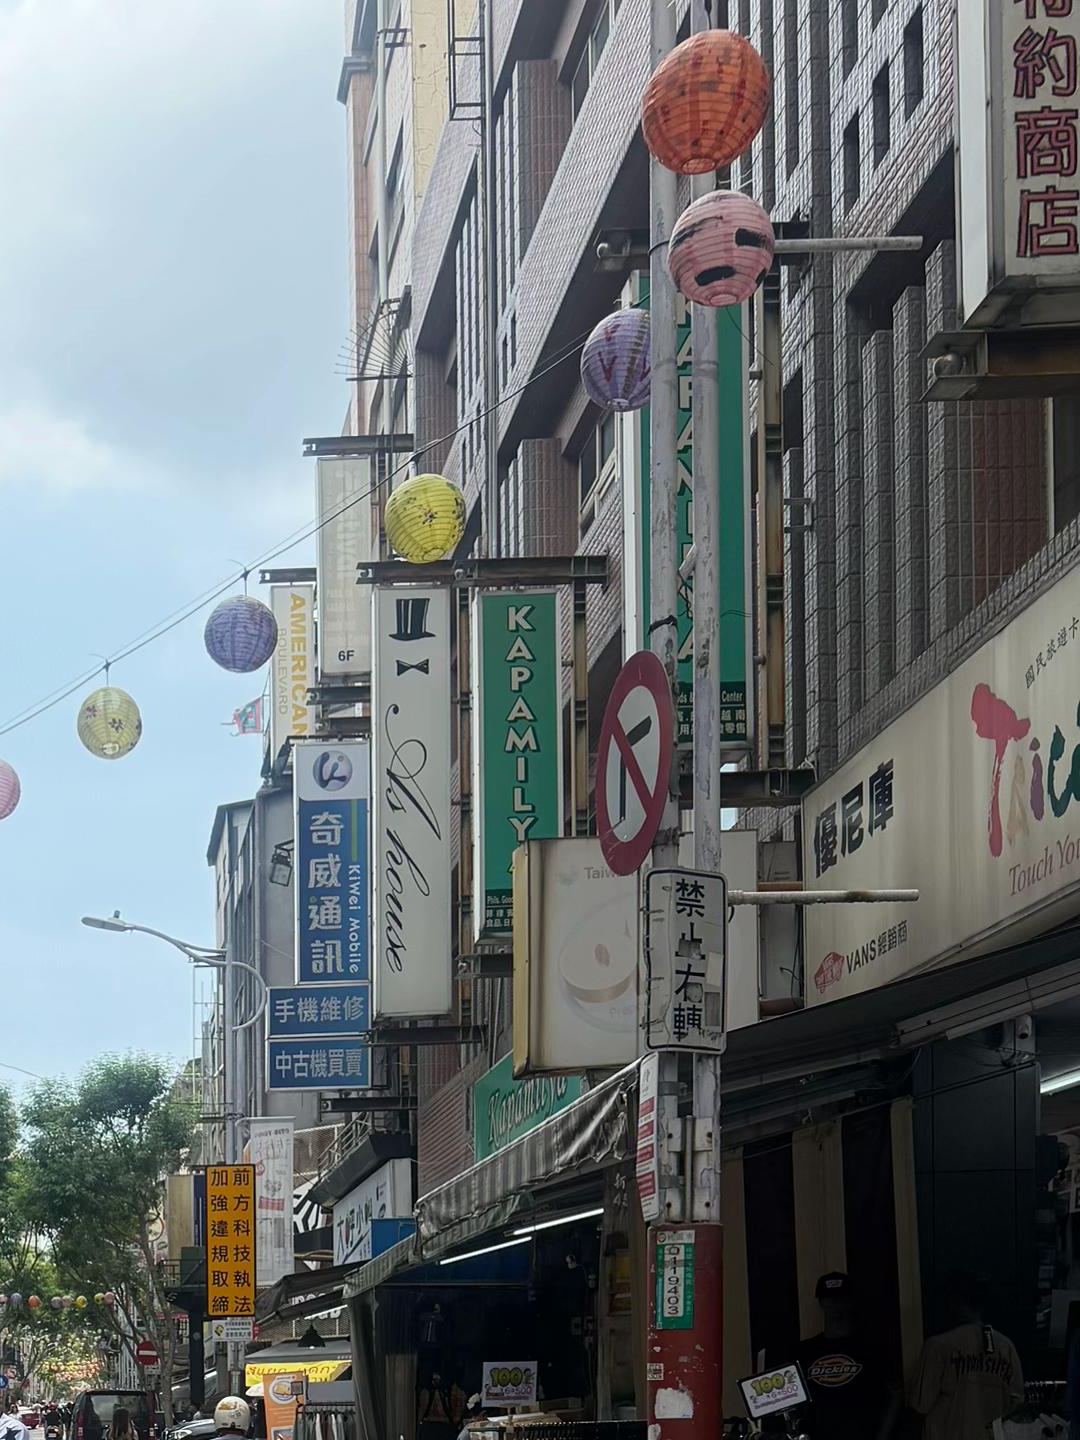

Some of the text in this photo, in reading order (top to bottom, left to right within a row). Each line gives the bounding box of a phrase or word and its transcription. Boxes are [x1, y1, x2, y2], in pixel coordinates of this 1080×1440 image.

[1013, 0, 1079, 258] 約商店
[338, 650, 355, 662] 6F
[721, 690, 744, 703] Center
[504, 605, 540, 873] KAPAMILY
[813, 758, 894, 878] 優尼庫
[307, 811, 345, 975] 奇威通訊
[386, 828, 430, 973] house
[1009, 846, 1054, 897] Touch
[348, 917, 362, 975] Mobile
[673, 878, 705, 1042] 禁止右轉
[274, 995, 364, 1024] 手機維修
[275, 1048, 363, 1079] 中古機買賣
[210, 1169, 229, 1313] 加強違規取締
[232, 1168, 251, 1313] 前方科技執法
[667, 1246, 680, 1316] 0119403
[489, 1367, 523, 1388] 100
[750, 1371, 786, 1396] 100
[811, 1363, 858, 1376] Dickies
